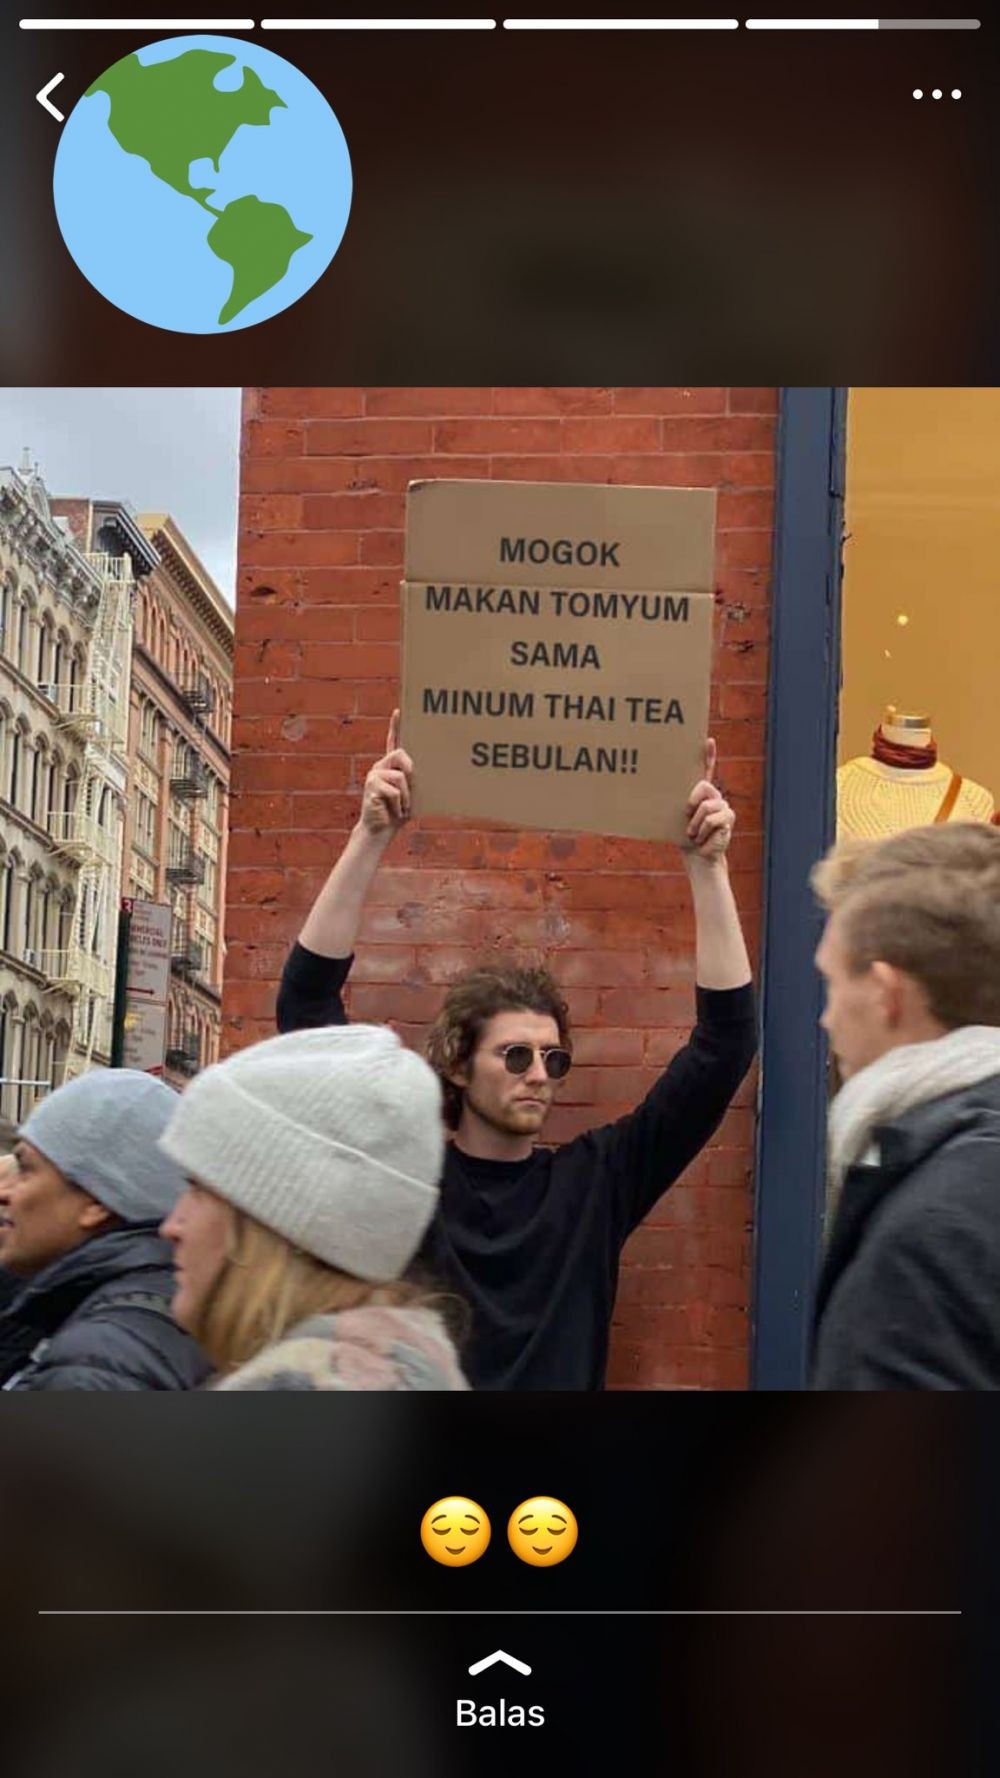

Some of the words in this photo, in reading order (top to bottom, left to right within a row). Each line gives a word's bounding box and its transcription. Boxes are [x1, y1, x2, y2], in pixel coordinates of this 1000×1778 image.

[499, 536, 621, 568] MOGOK
[425, 585, 540, 616] MAKAN
[549, 591, 690, 622] TOMYUM
[510, 640, 601, 670] SAMA
[422, 687, 534, 718] MINUM
[543, 693, 616, 722] THAI
[624, 697, 685, 725] TEA
[470, 741, 640, 775] SEBULAN!!
